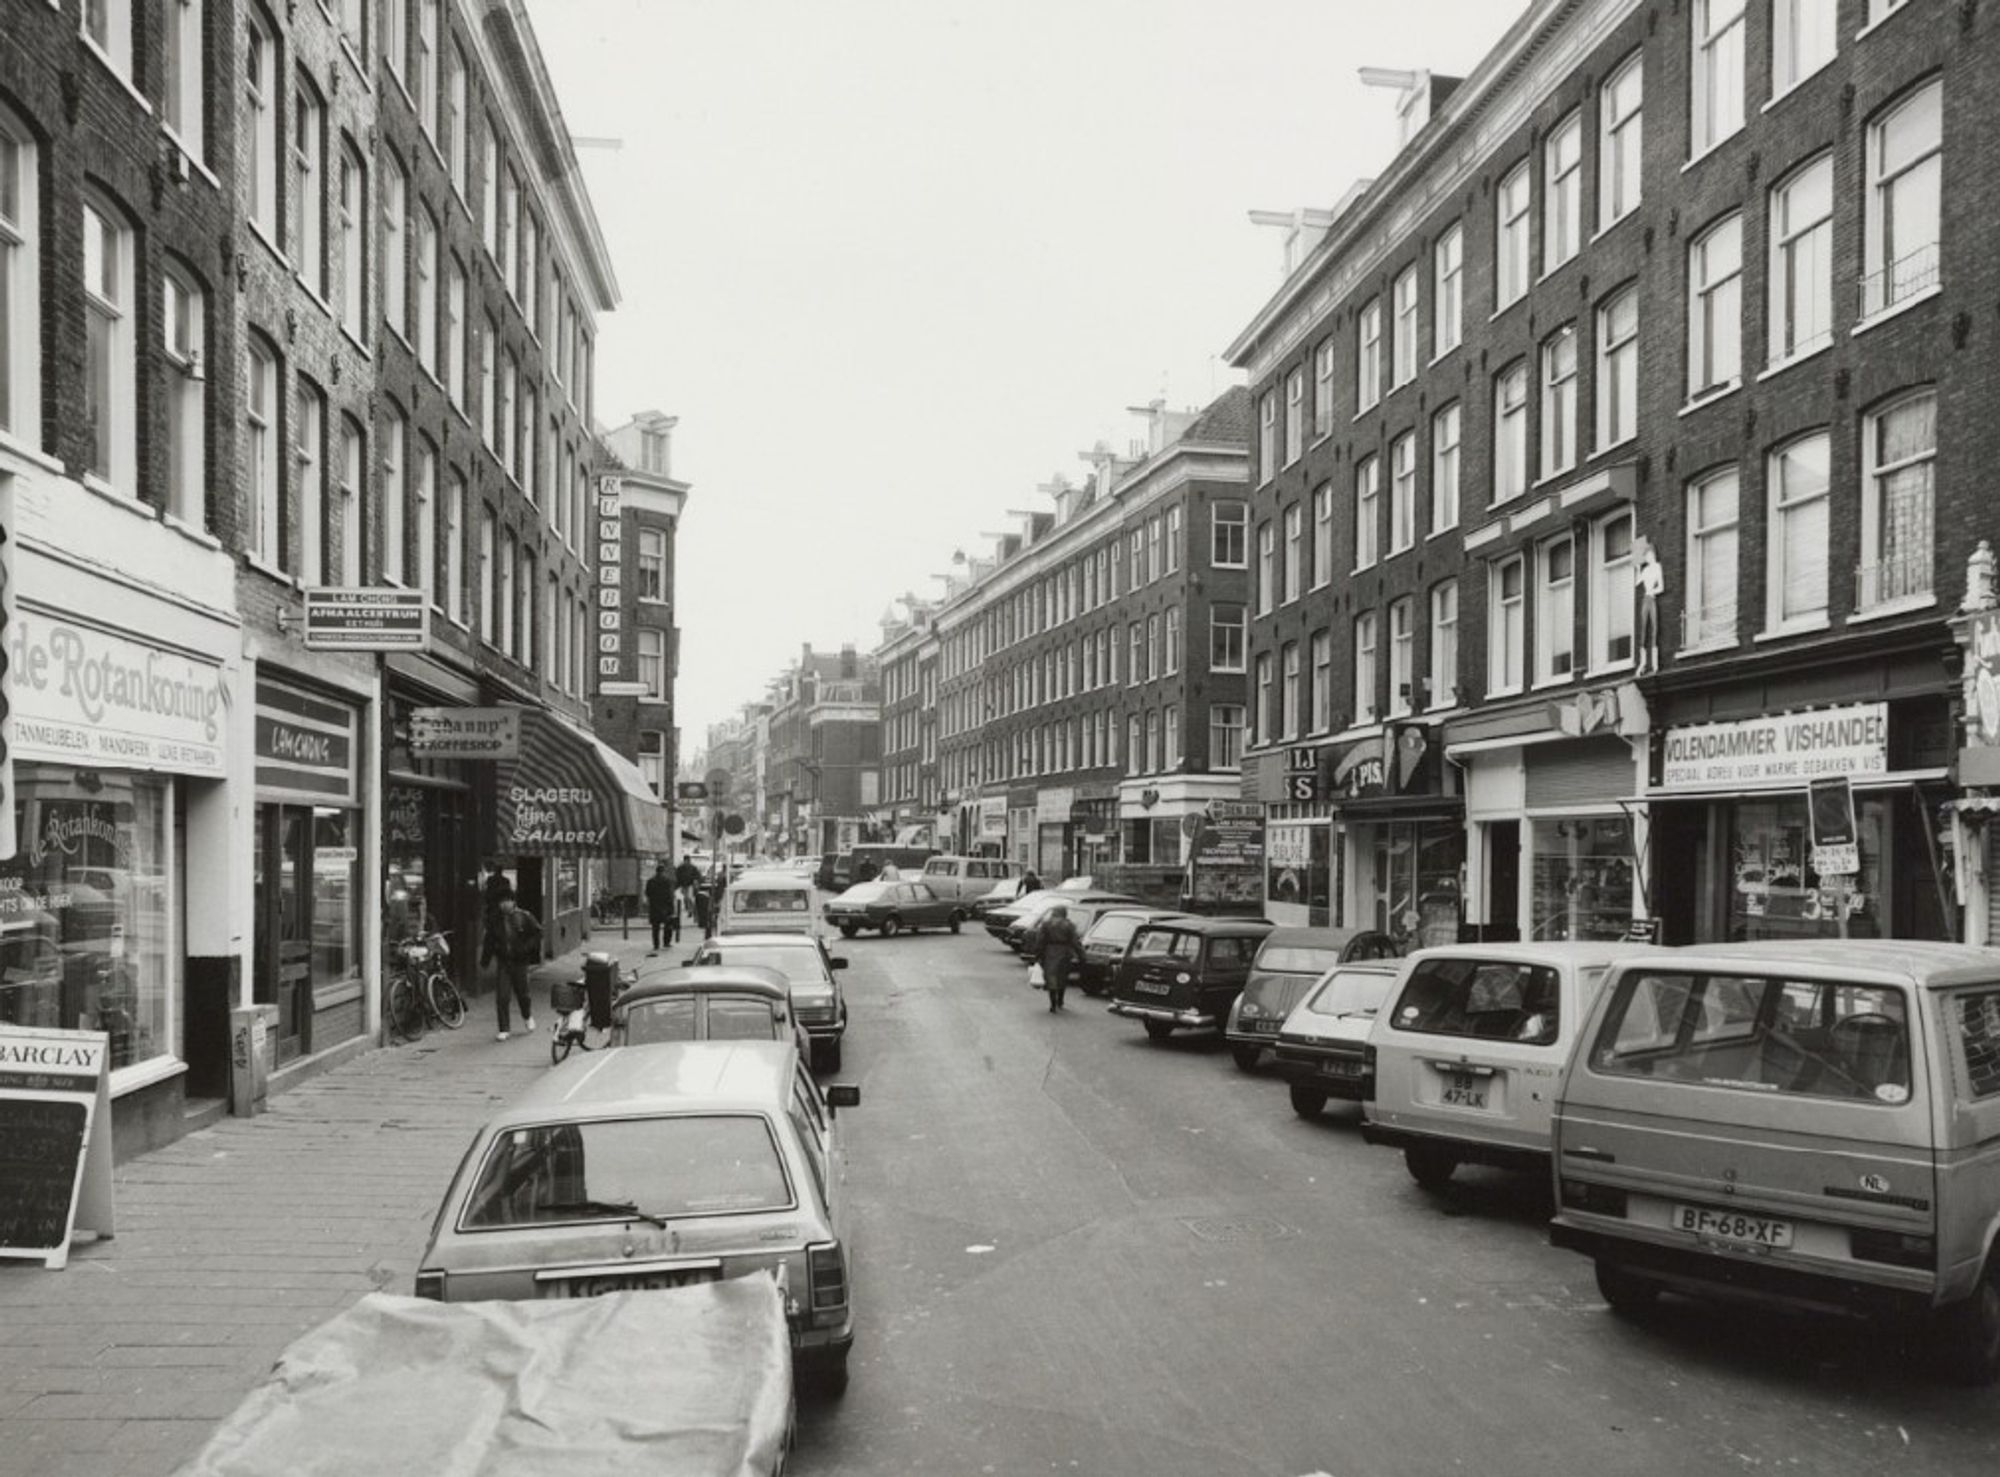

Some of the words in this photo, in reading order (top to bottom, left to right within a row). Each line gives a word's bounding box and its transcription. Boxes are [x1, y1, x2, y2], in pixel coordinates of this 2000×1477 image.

[12, 621, 48, 690] de
[51, 626, 218, 742] Rotankoning
[1665, 727, 1777, 763] VOLENDAMMER
[1784, 715, 1885, 752] VISHANDEL
[510, 786, 593, 803] SLAGERIJ
[511, 826, 607, 845] SALADES!
